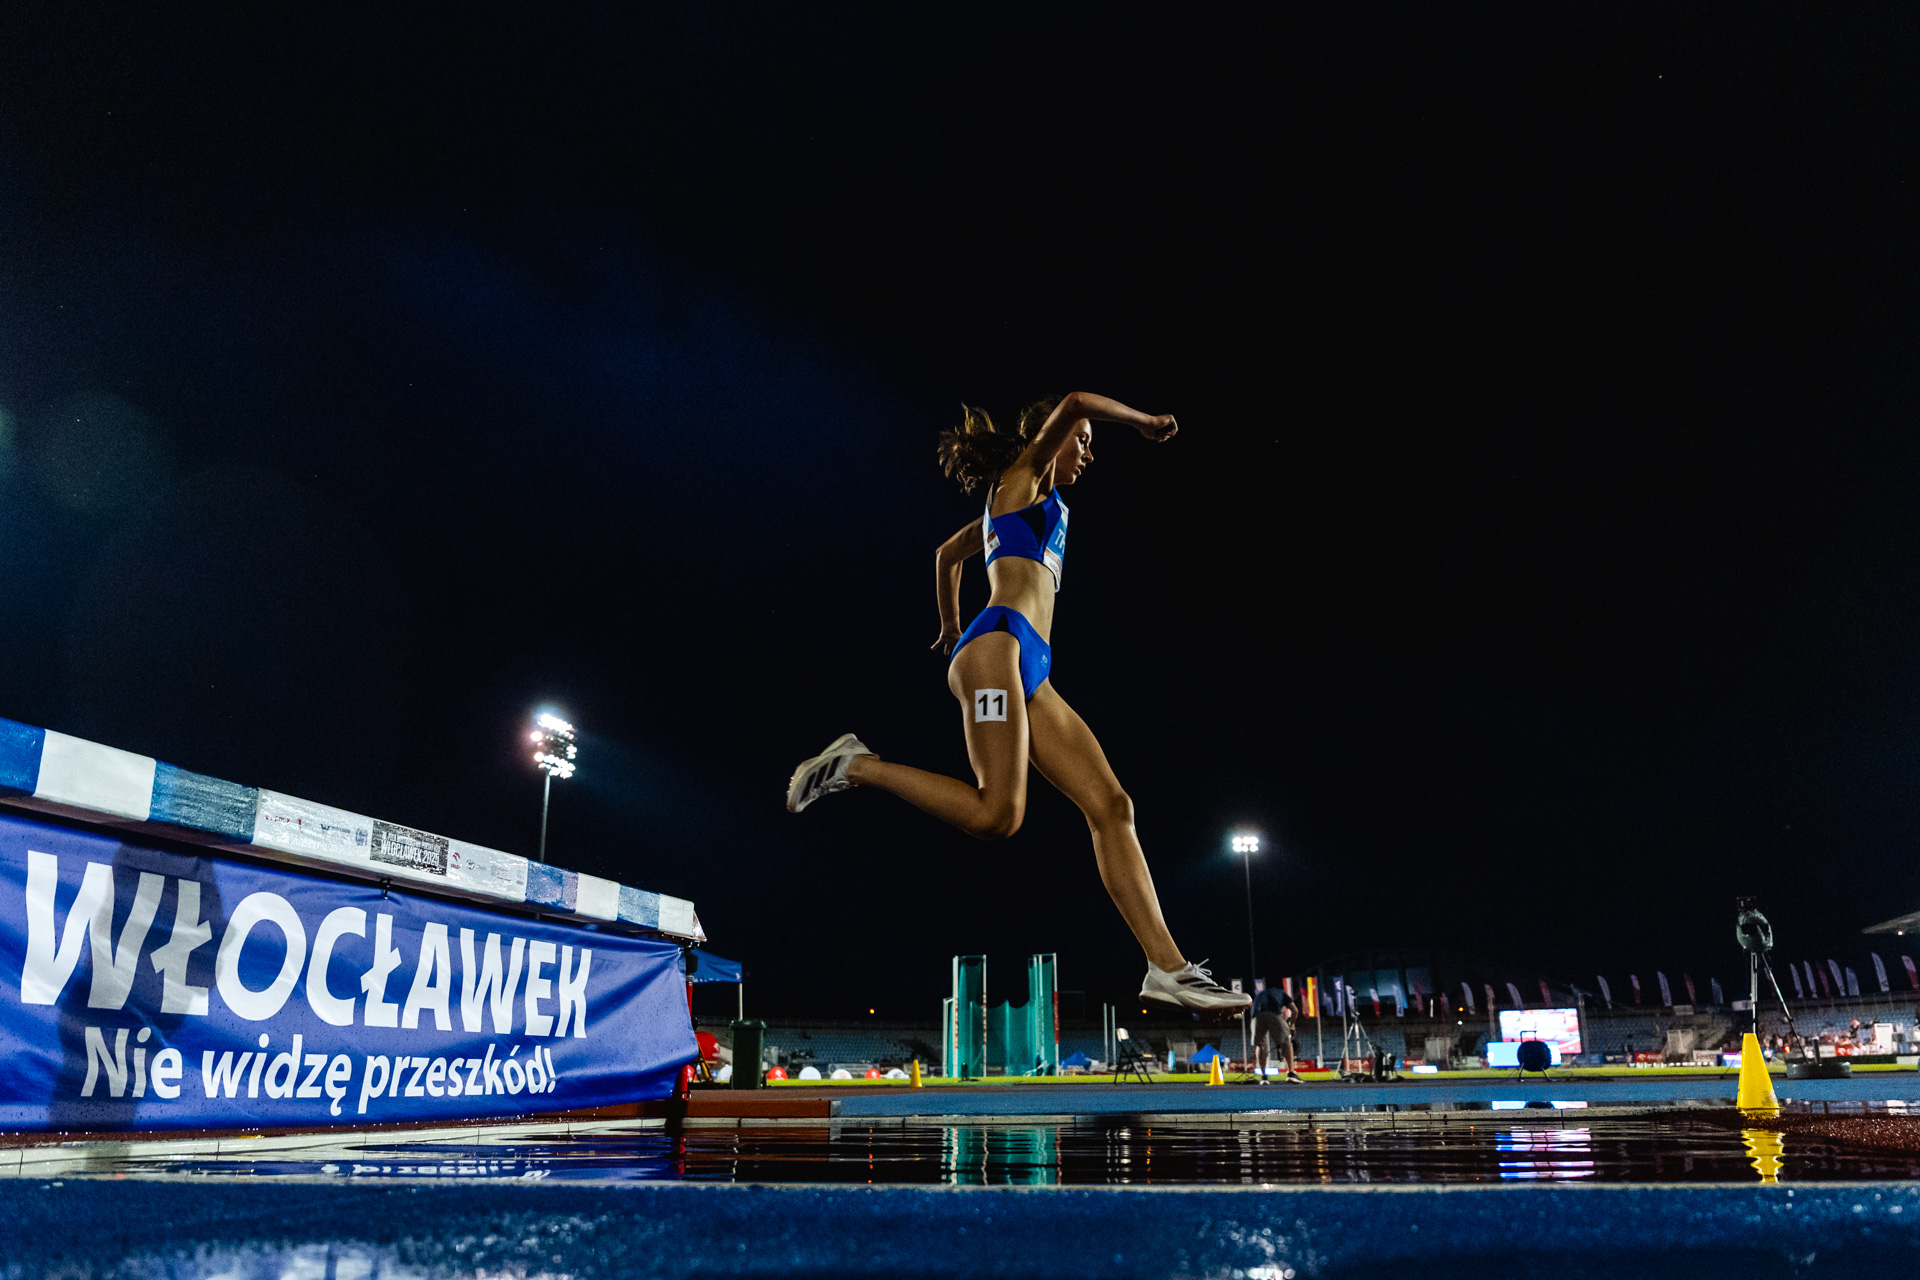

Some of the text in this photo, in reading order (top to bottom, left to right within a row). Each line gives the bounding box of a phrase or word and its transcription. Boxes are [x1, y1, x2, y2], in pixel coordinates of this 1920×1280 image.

[978, 694, 1003, 716] 11
[21, 850, 592, 1038] WŁOCŁAWEK
[81, 1027, 556, 1116] Nie widzę przeszkód!
